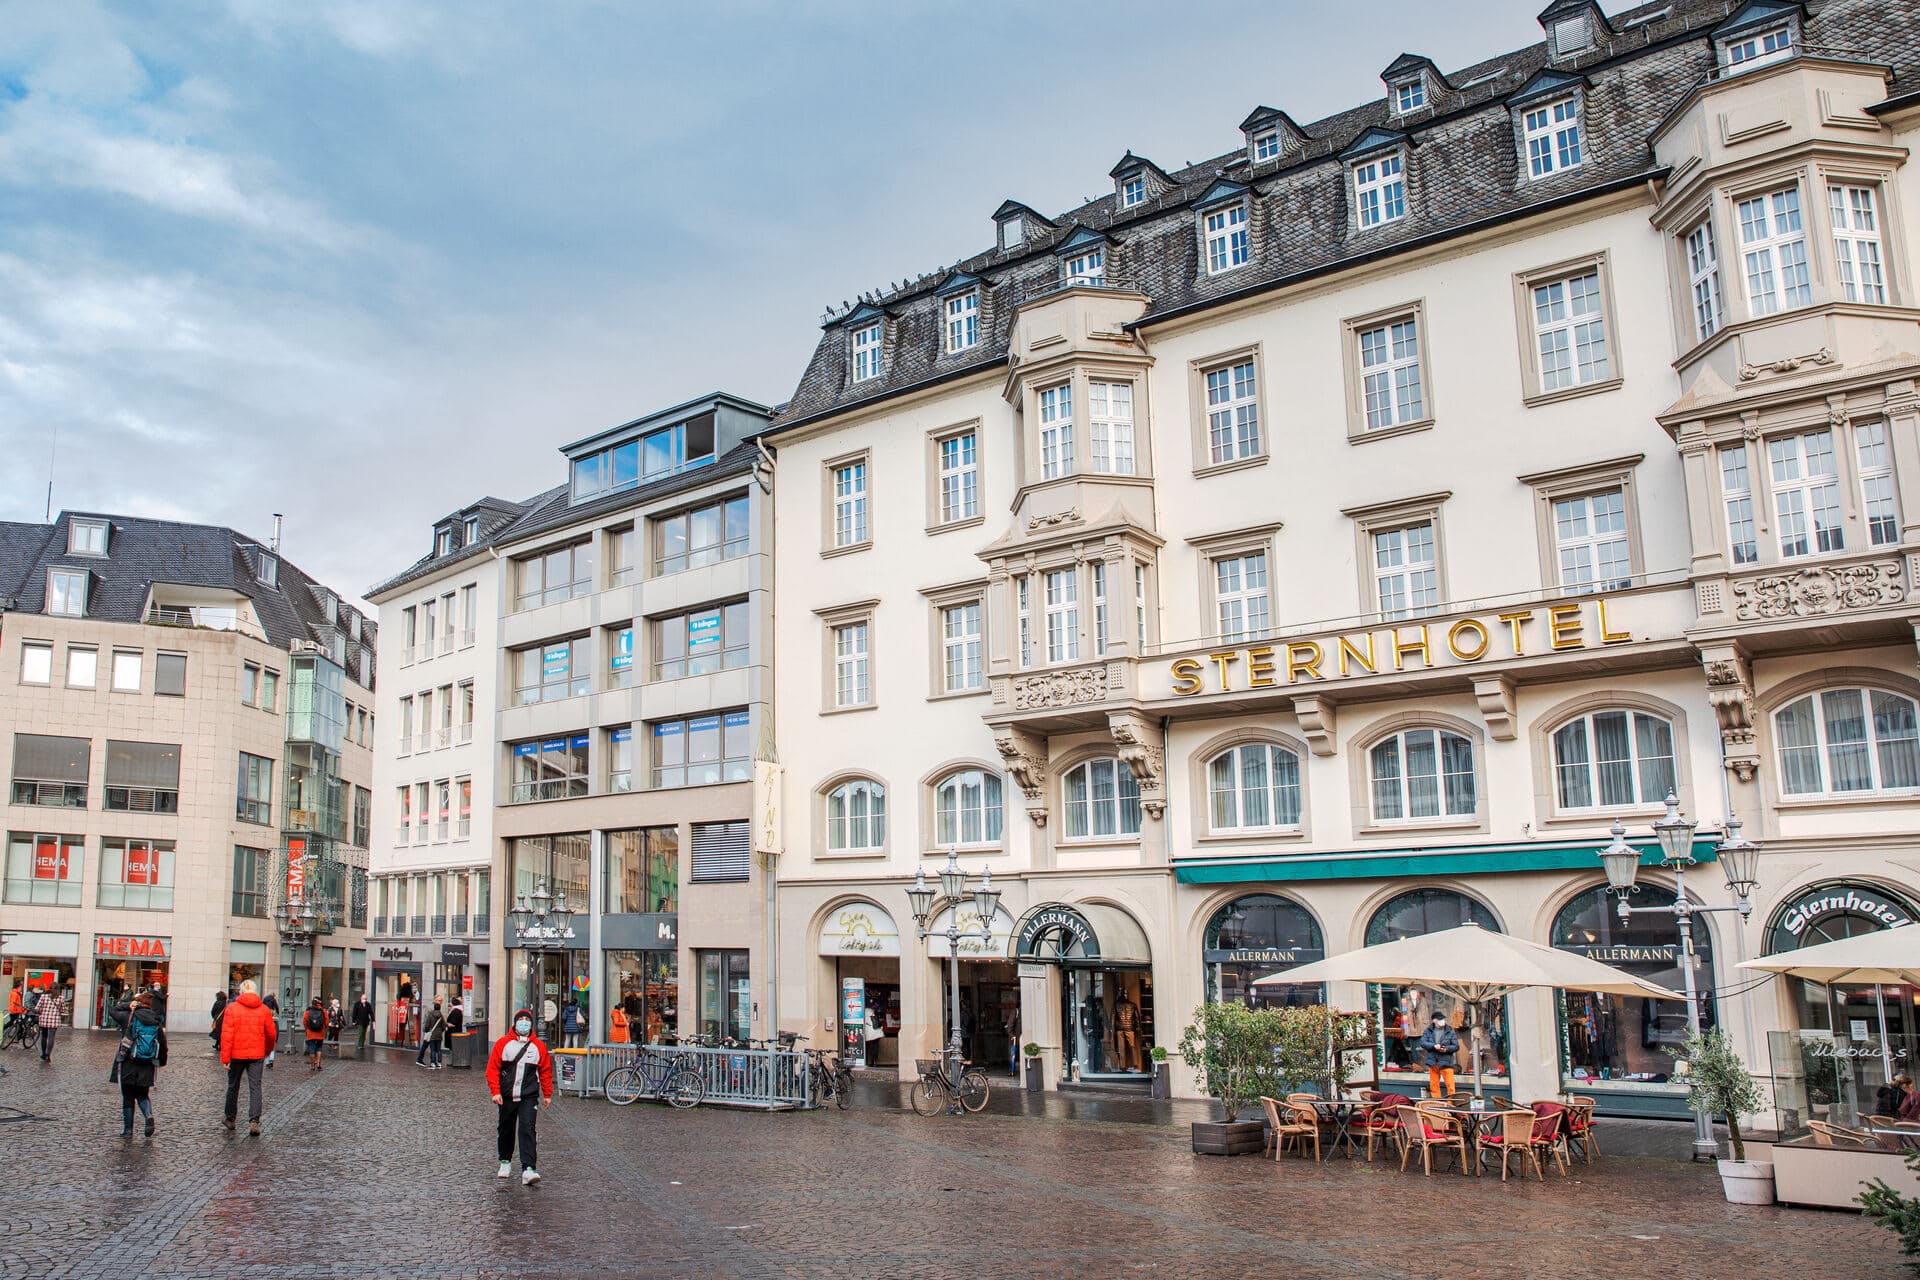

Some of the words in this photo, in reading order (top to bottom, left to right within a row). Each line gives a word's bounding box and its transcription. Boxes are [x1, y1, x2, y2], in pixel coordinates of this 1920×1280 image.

[1170, 599, 1633, 696] STERNHOTEL
[1783, 890, 1911, 936] Sternhotel
[1023, 913, 1091, 943] ALLERMANN
[97, 937, 166, 958] HEMA
[1228, 950, 1296, 962] ALLERMANN
[1586, 948, 1674, 960] ALLERMANN
[1811, 1040, 1908, 1062] Miebacs
